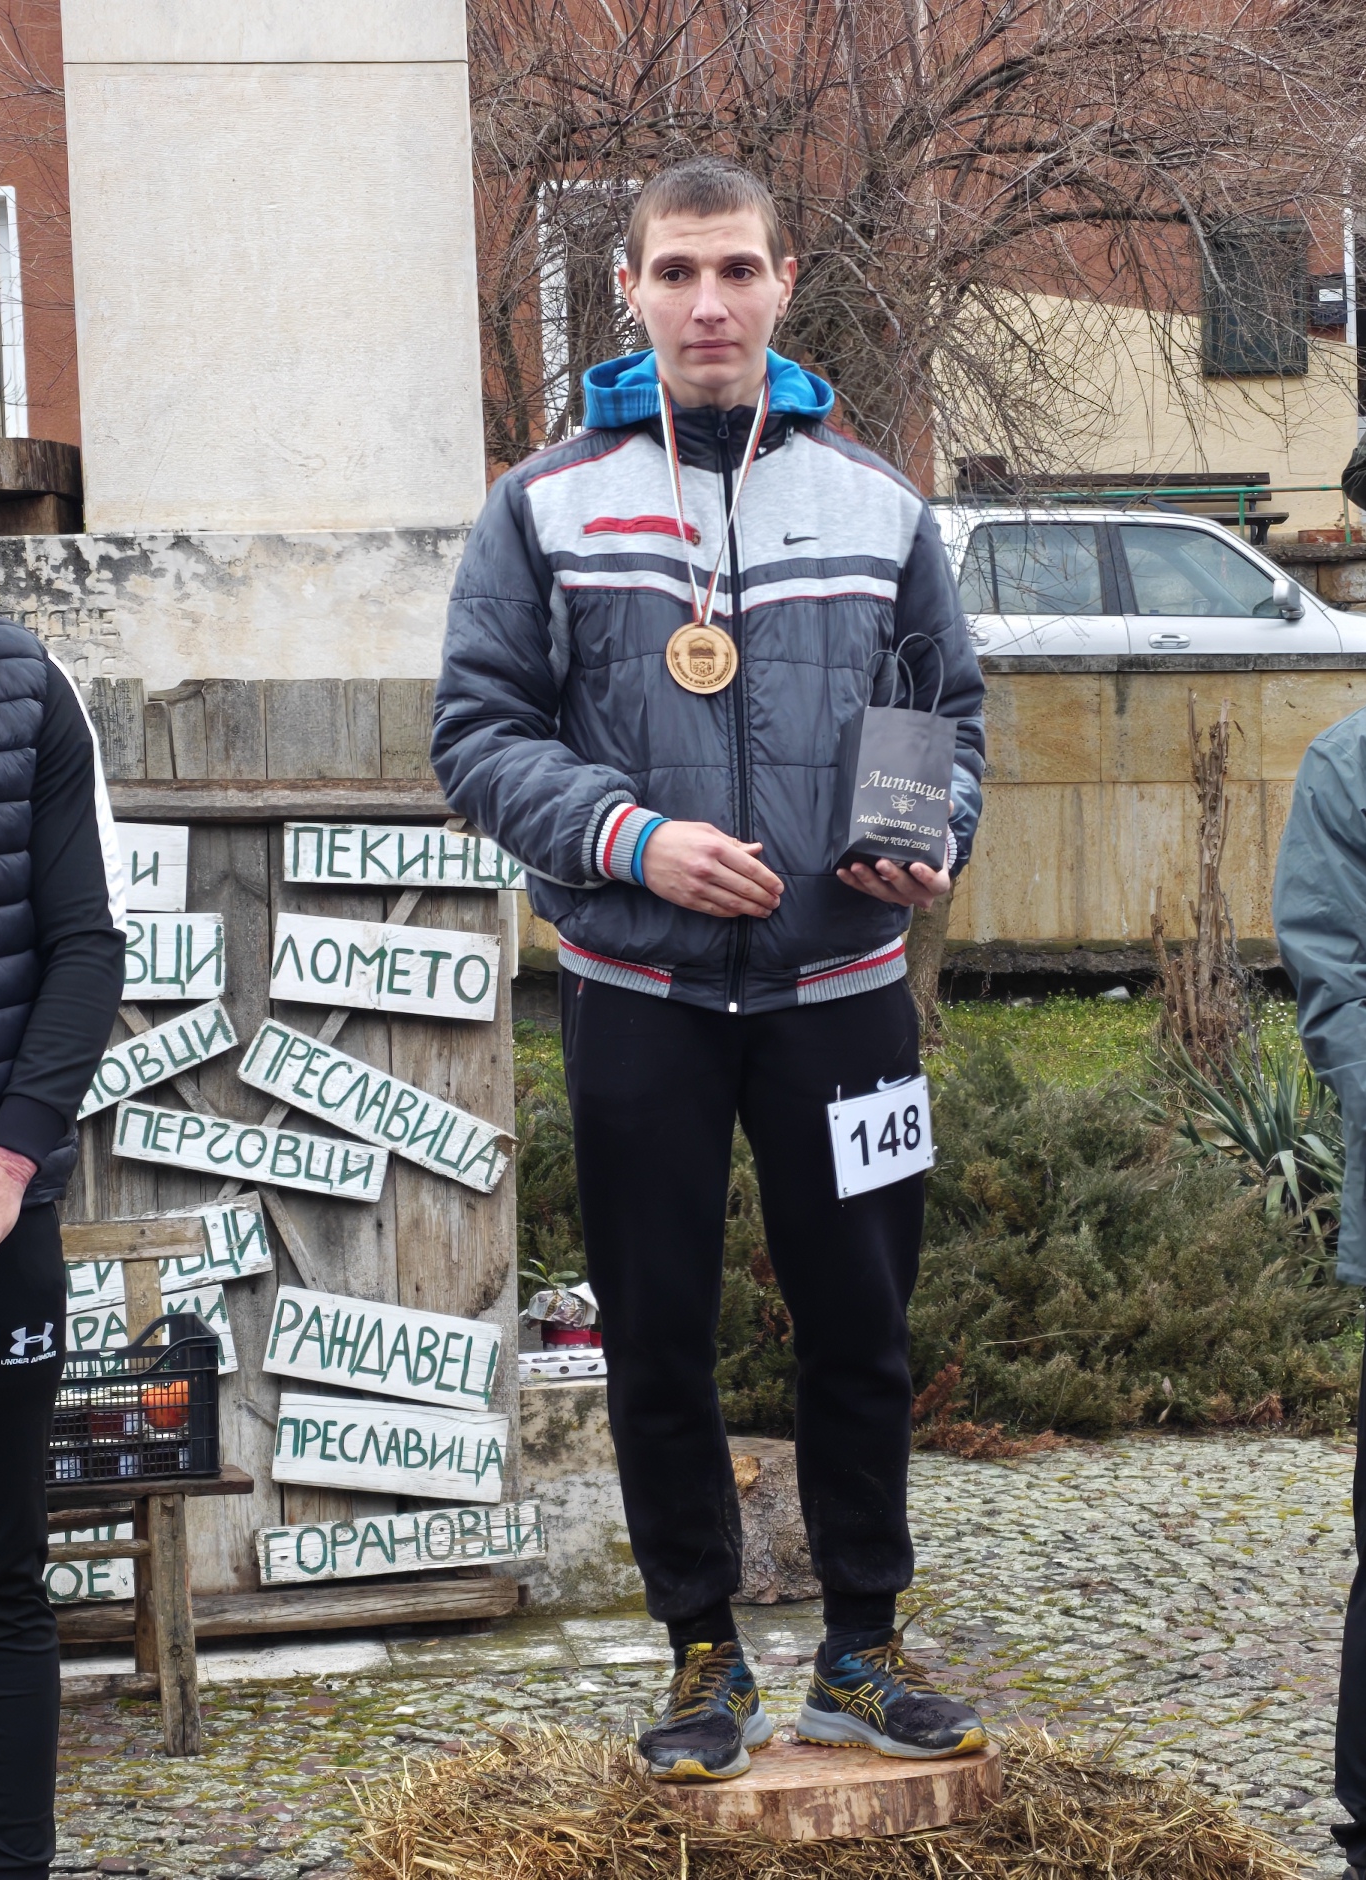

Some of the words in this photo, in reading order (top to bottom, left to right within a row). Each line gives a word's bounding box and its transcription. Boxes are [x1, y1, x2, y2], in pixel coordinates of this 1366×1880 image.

[860, 770, 946, 801] Липница
[857, 811, 916, 832] меденото
[918, 825, 943, 838] село
[272, 933, 490, 1004] ЛОМЕТО
[245, 1025, 497, 1183] ПРЕСЛАВИЦА
[850, 1104, 921, 1166] 148
[118, 1107, 374, 1191] ПЕРГОВЦИ
[0, 1357, 30, 1366] UNDER
[30, 1350, 57, 1364] ARMOUR
[268, 1298, 500, 1403] РАЖДАВЕЦ
[275, 1416, 505, 1486] ПРЕСЛАВИЦА
[262, 1501, 544, 1580] ГОРАНОВЦИ
